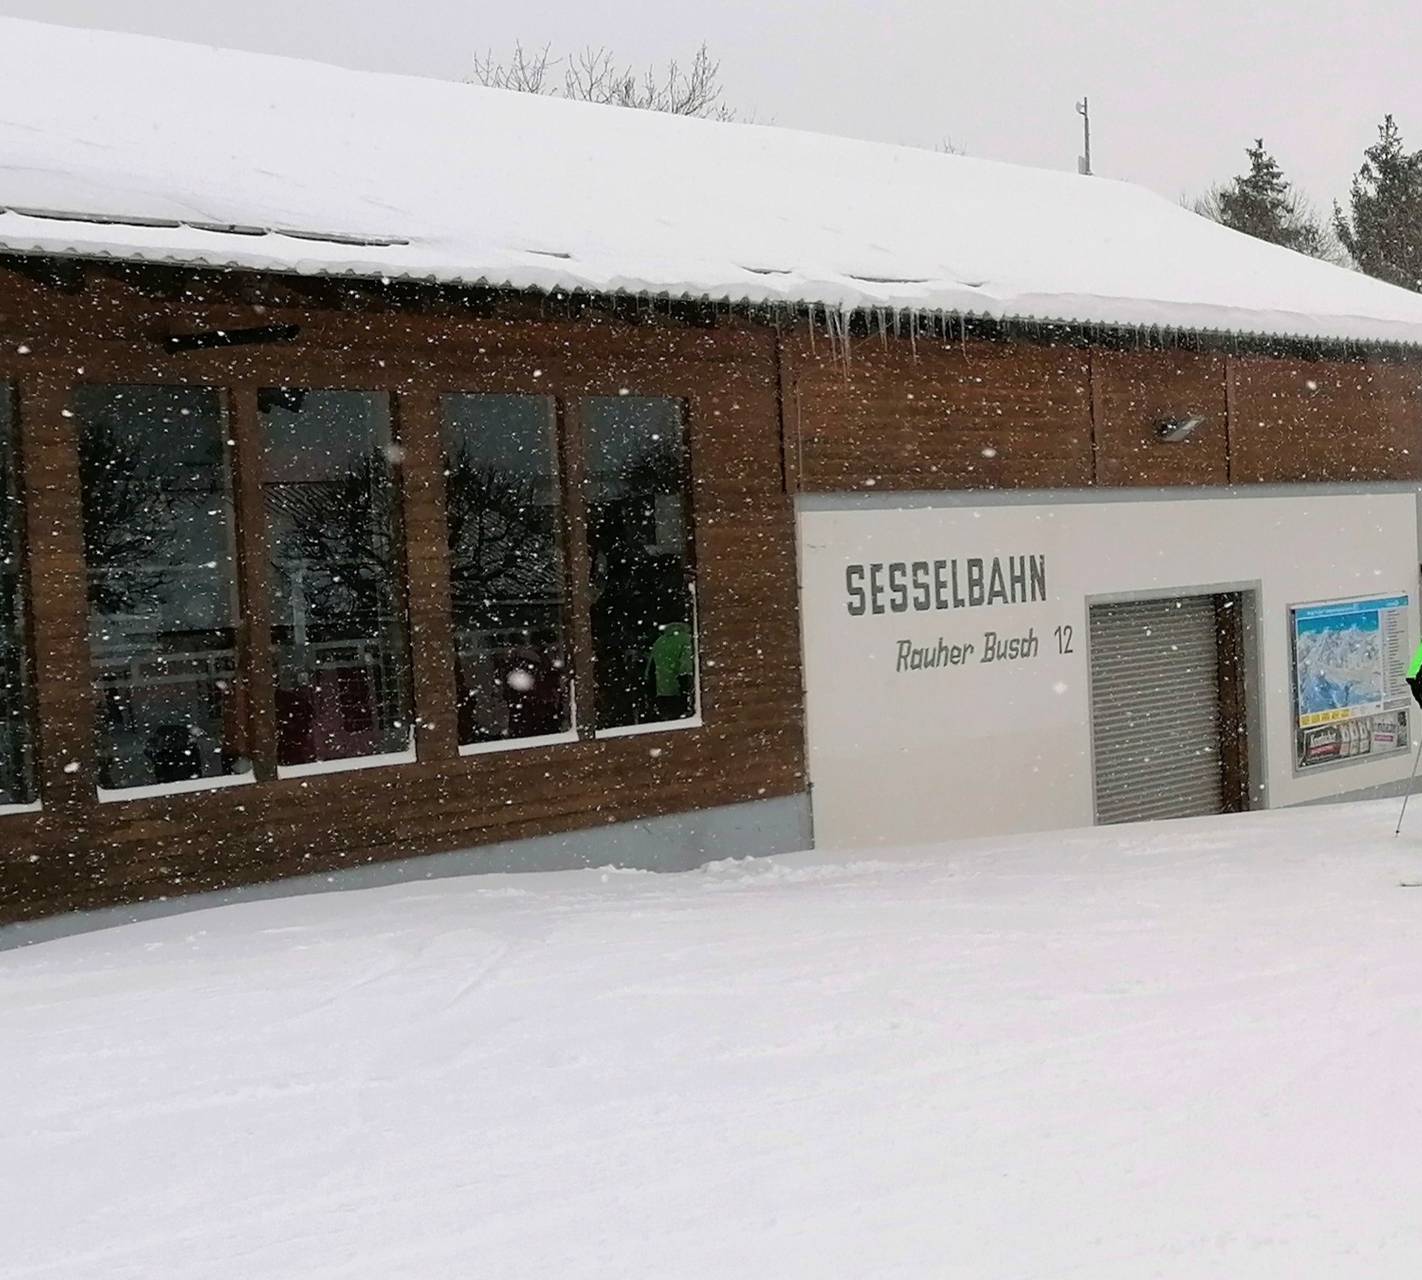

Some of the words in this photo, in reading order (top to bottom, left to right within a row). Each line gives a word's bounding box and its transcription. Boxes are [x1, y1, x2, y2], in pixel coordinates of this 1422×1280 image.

[846, 554, 1047, 616] SESSELBAHN
[896, 636, 974, 672] Rauher
[980, 627, 1039, 663] Busch
[1054, 625, 1074, 655] 12
